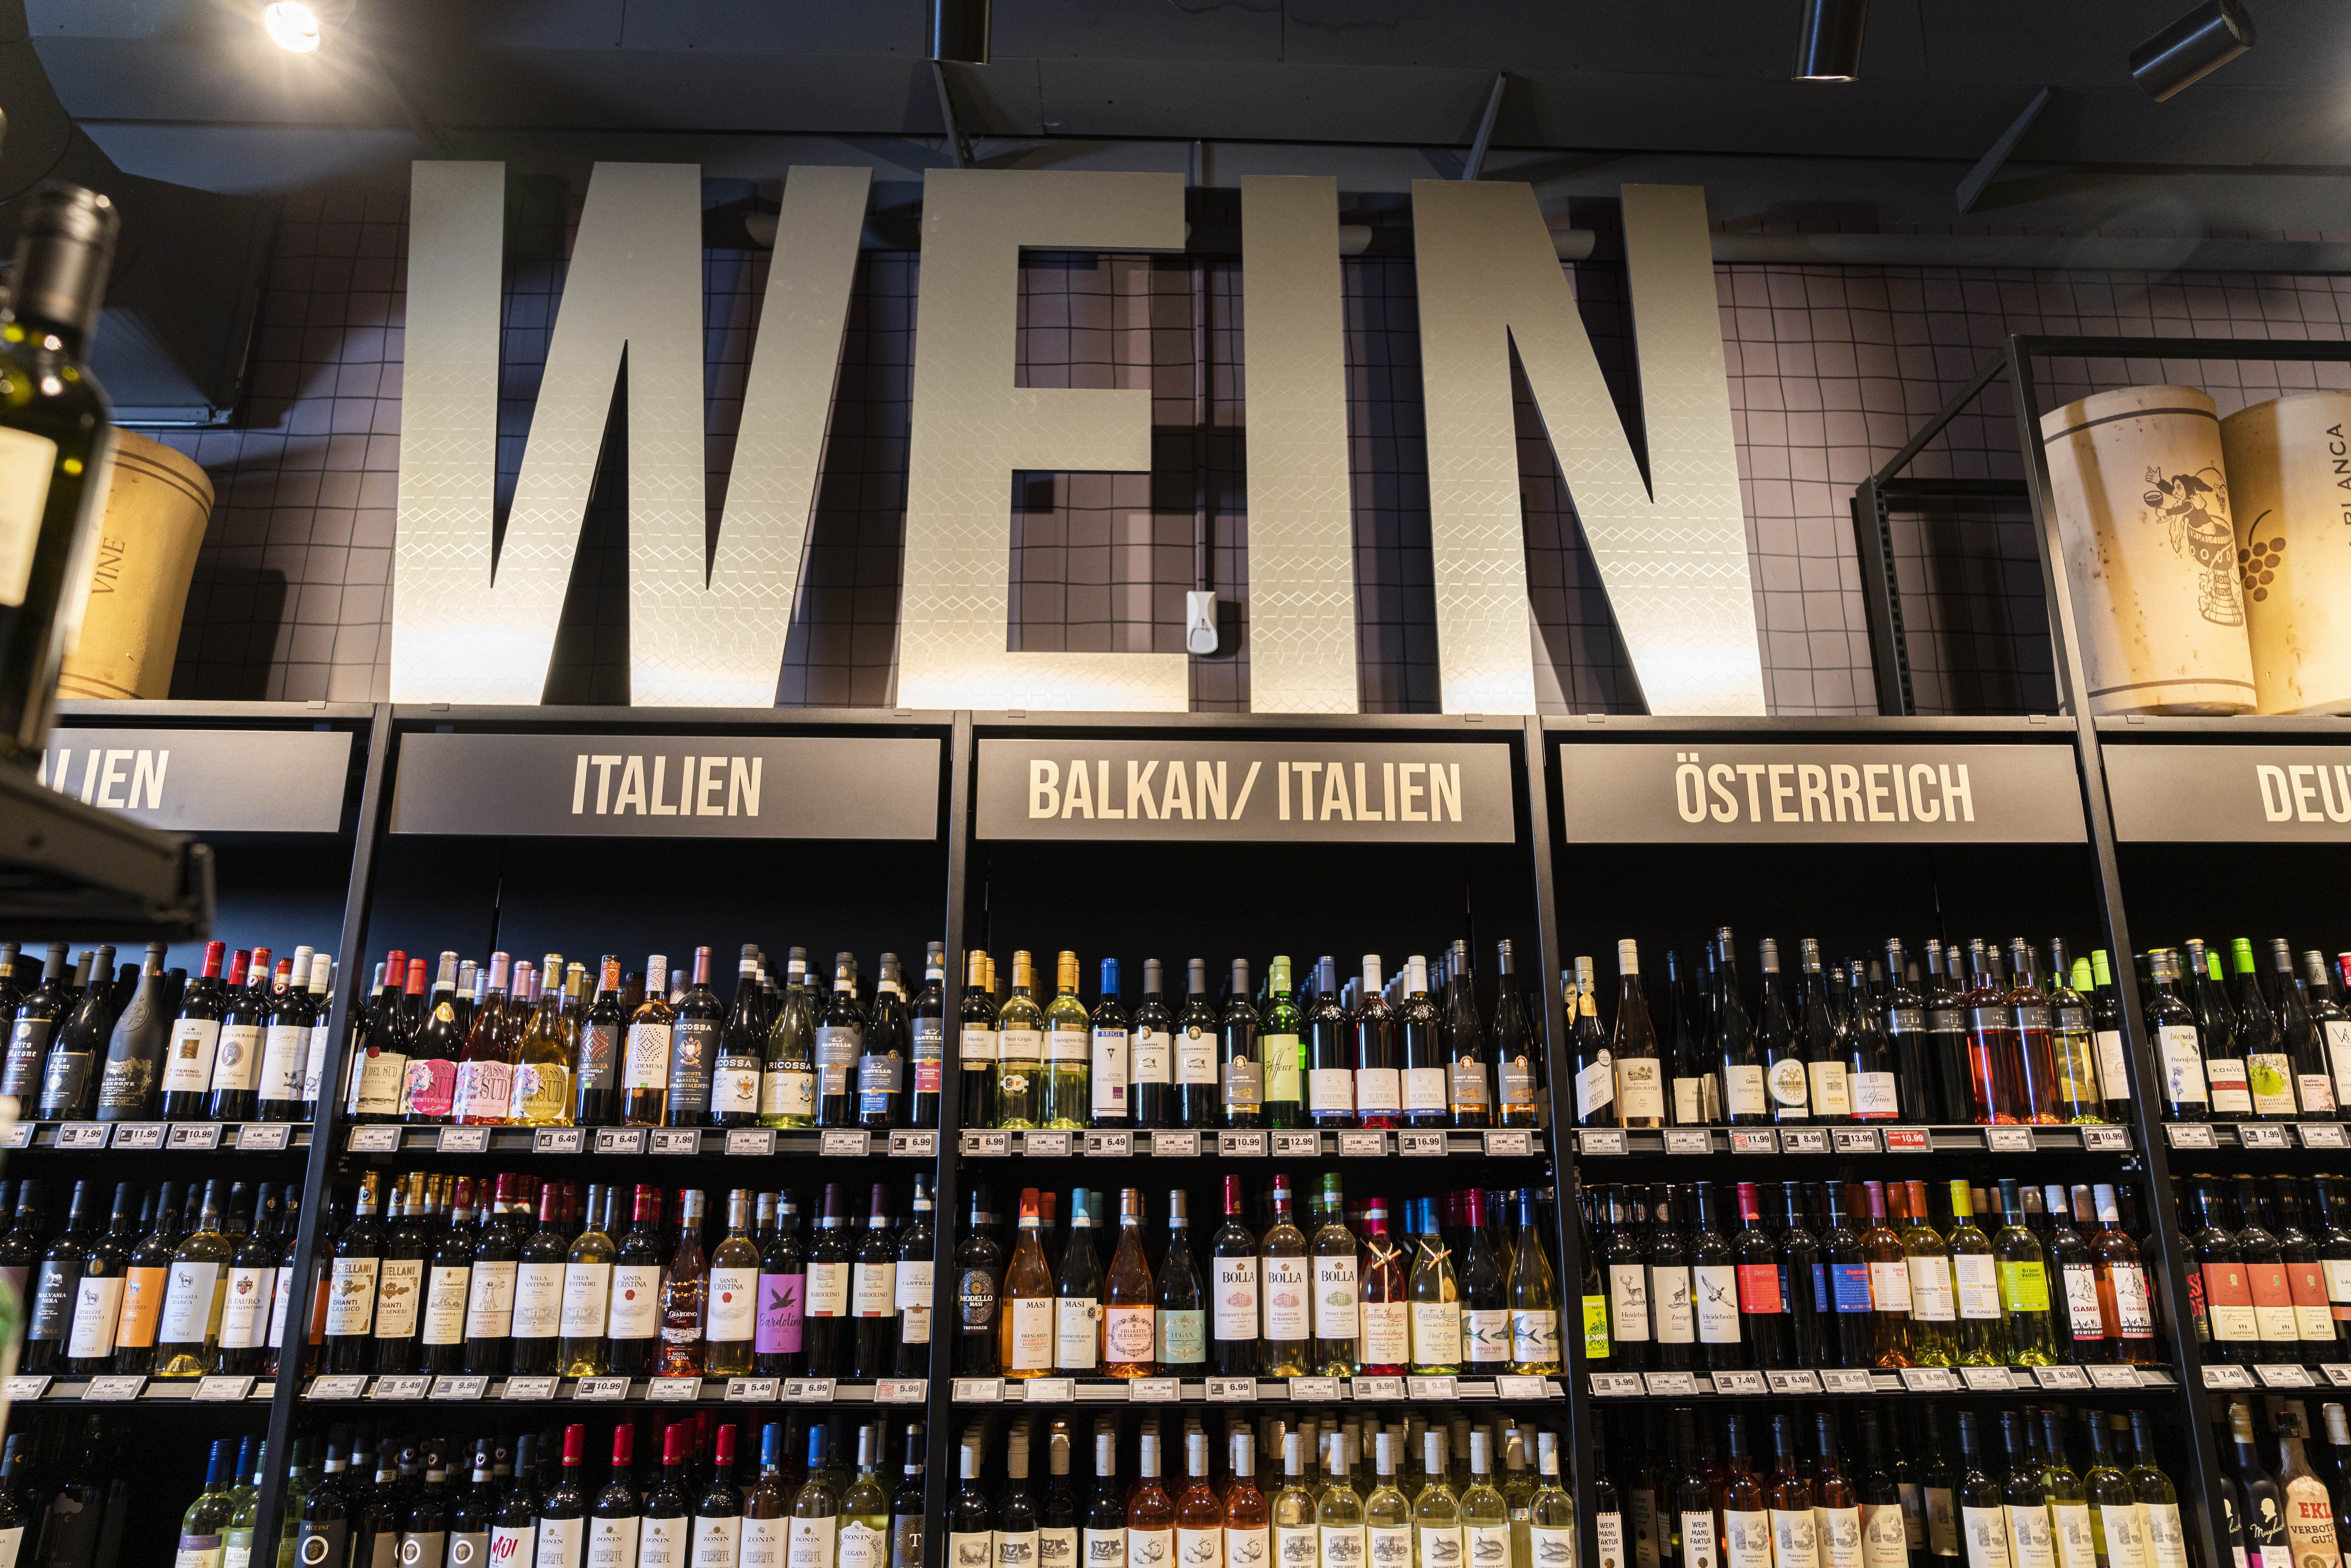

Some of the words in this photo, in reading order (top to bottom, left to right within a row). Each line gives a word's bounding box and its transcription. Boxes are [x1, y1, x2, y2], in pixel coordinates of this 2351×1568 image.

[391, 161, 1766, 716] WEIN
[91, 537, 126, 596] VINE
[571, 755, 763, 816] ITALIEN
[1029, 759, 1252, 822] BALKAN/
[1277, 762, 1462, 822] ITALIEN
[1675, 753, 1974, 822] ÖSTERREICH
[2256, 764, 2351, 822] DEU
[483, 1064, 507, 1076] PASSO
[768, 1061, 811, 1070] RICOSSA
[382, 1067, 398, 1078] SUD
[539, 1066, 563, 1078] PASSO
[481, 1077, 508, 1100] SUD
[768, 1076, 789, 1091] Gavi
[537, 1080, 563, 1102] SUD
[134, 1130, 158, 1138] 11.99
[189, 1130, 212, 1138] 10.99
[1223, 1272, 1254, 1283] BOLLA
[1269, 1272, 1302, 1283] BOLLA
[1322, 1271, 1354, 1282] BOLLA
[596, 1382, 621, 1390] 10.99
